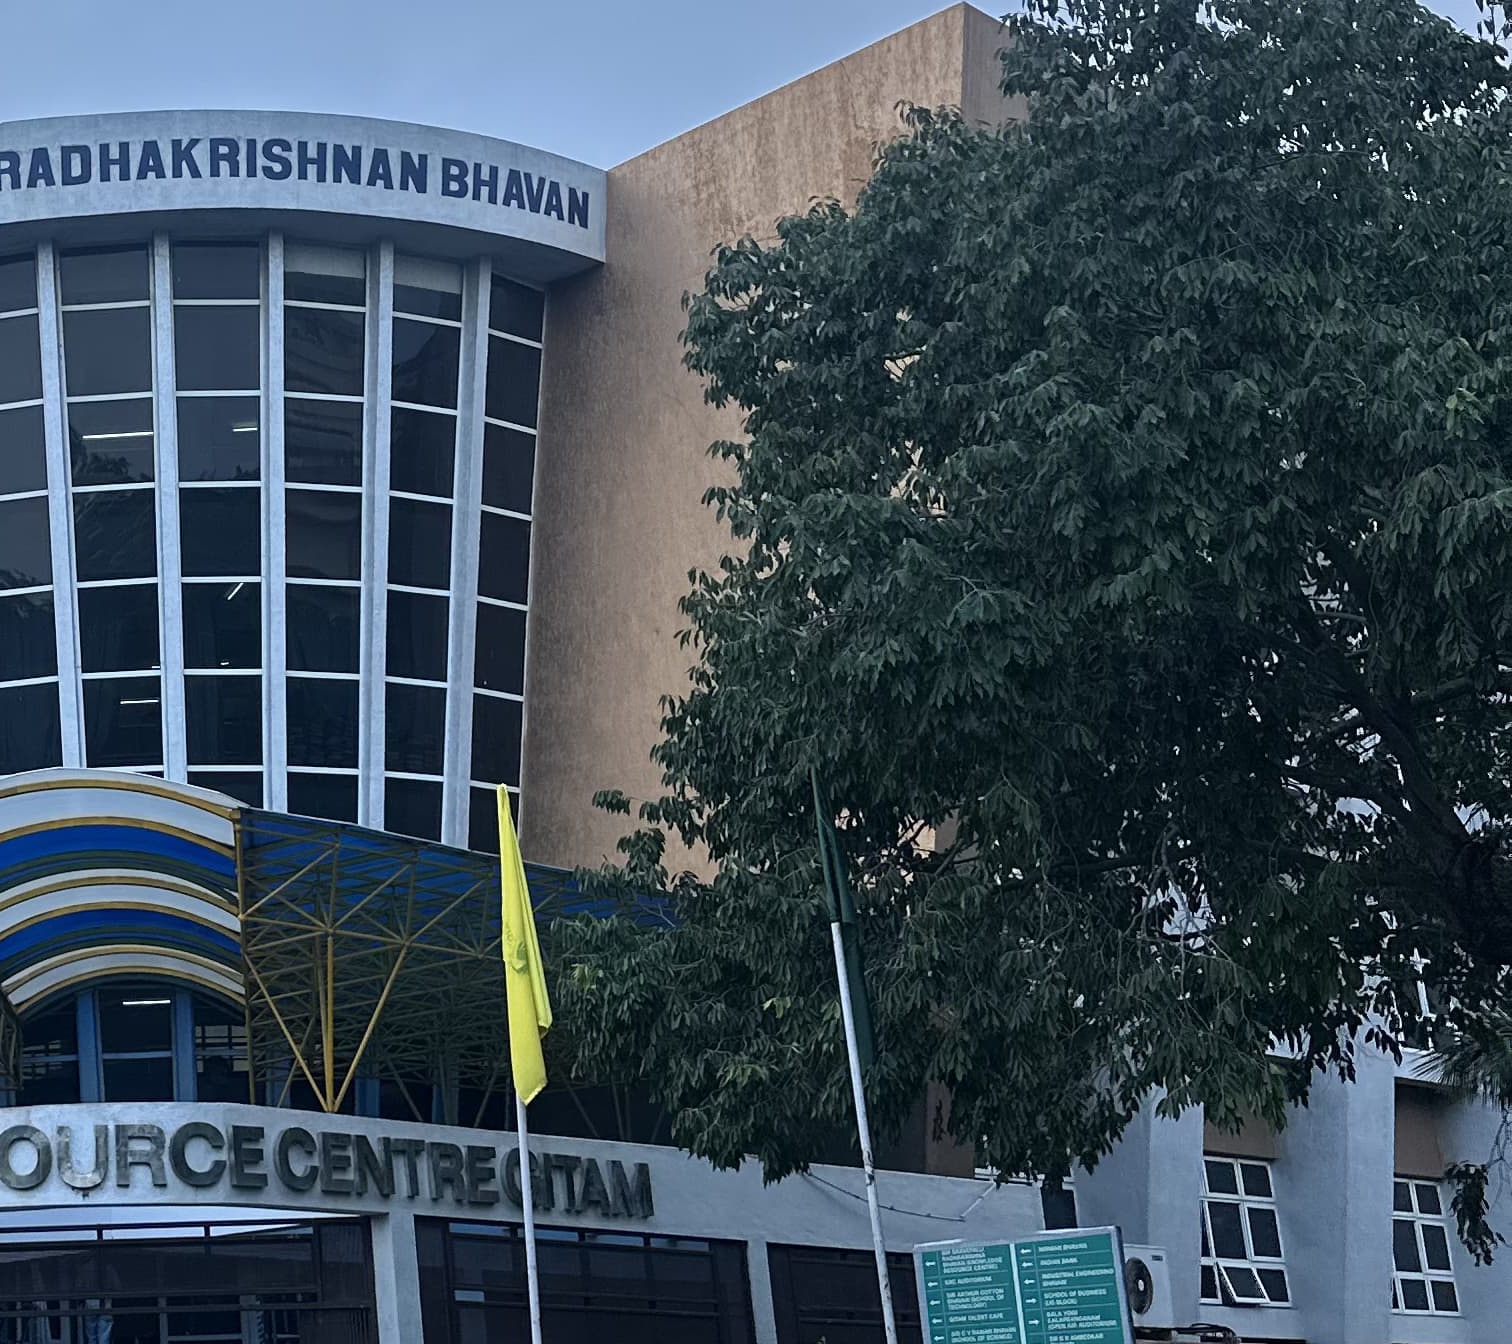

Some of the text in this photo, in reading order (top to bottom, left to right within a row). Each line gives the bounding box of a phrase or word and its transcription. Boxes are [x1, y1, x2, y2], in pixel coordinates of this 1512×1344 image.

[441, 157, 590, 229] BHAVAN
[274, 1127, 500, 1205] CENTRE
[501, 1147, 655, 1218] GITAM
